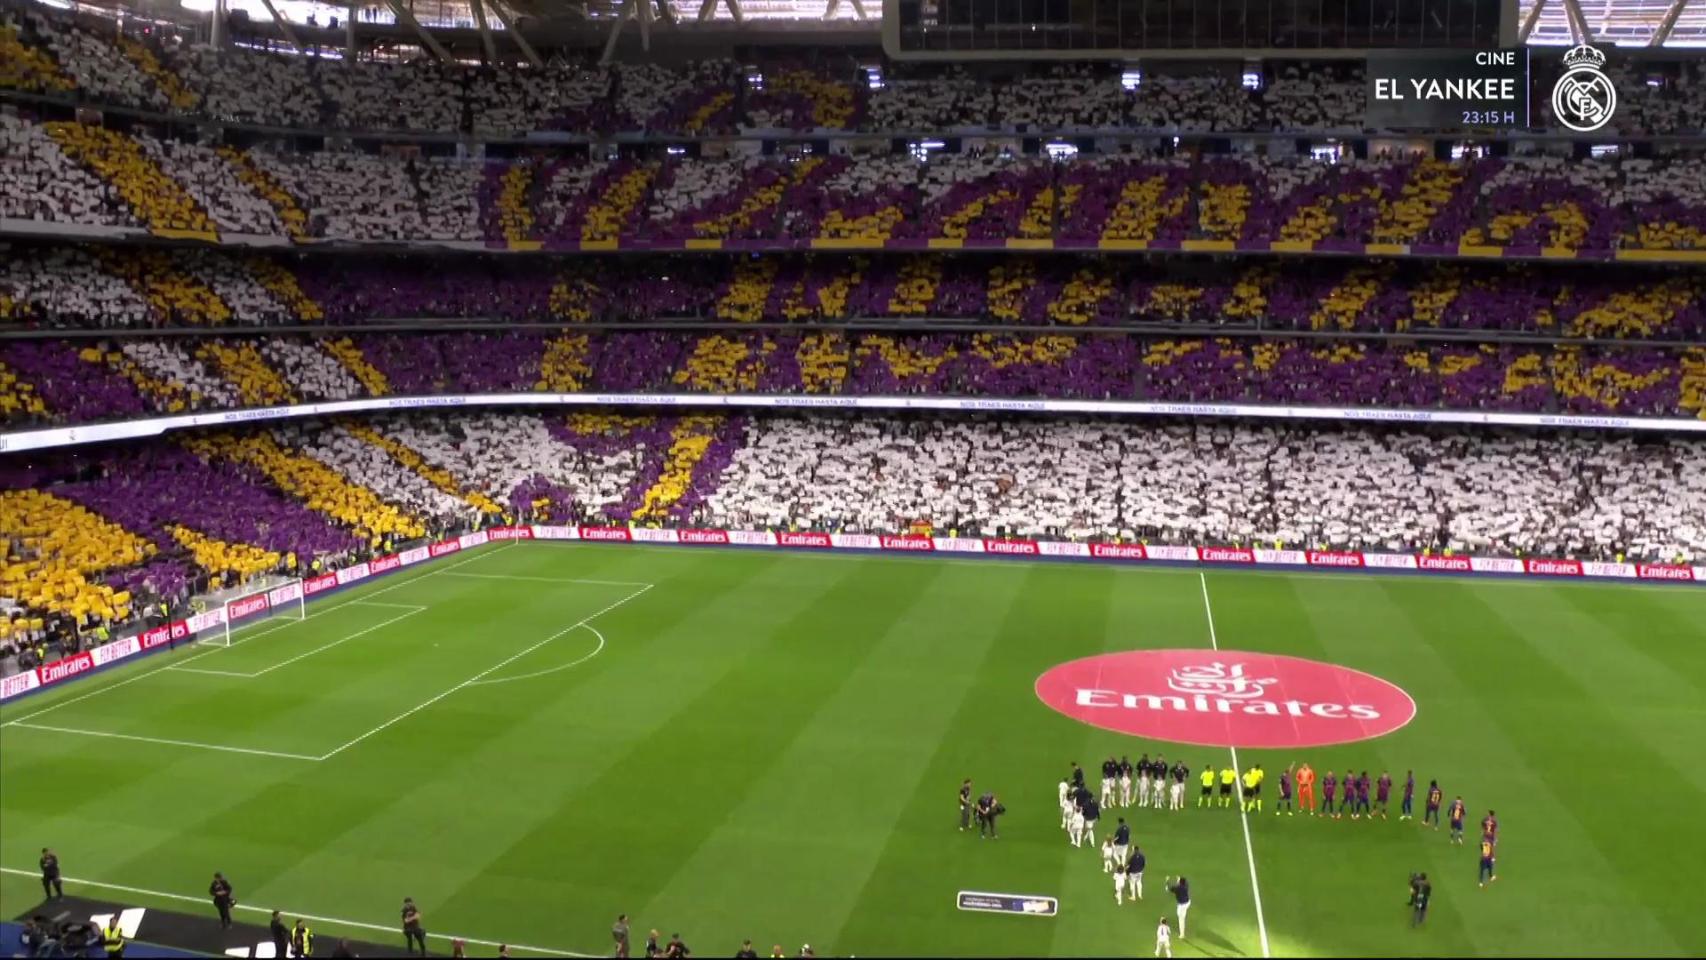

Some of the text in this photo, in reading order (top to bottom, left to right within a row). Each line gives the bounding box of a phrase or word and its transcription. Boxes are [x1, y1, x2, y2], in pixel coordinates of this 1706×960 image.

[490, 528, 529, 539] Emirates
[583, 527, 626, 540] Emirates
[681, 531, 726, 543] Emirates
[781, 534, 826, 546] Emirates
[884, 538, 931, 550] Emirates
[988, 541, 1035, 553] Emirates
[1094, 544, 1142, 557] Emirates
[1203, 548, 1250, 561] Emirates
[1311, 552, 1359, 565] Emirates
[1420, 556, 1468, 569] Emirates
[1529, 560, 1578, 574] Emirates
[1641, 565, 1690, 580] Emirates
[229, 597, 265, 620] Emirates
[42, 656, 90, 684] Emirates
[1075, 688, 1381, 720] Emirates
